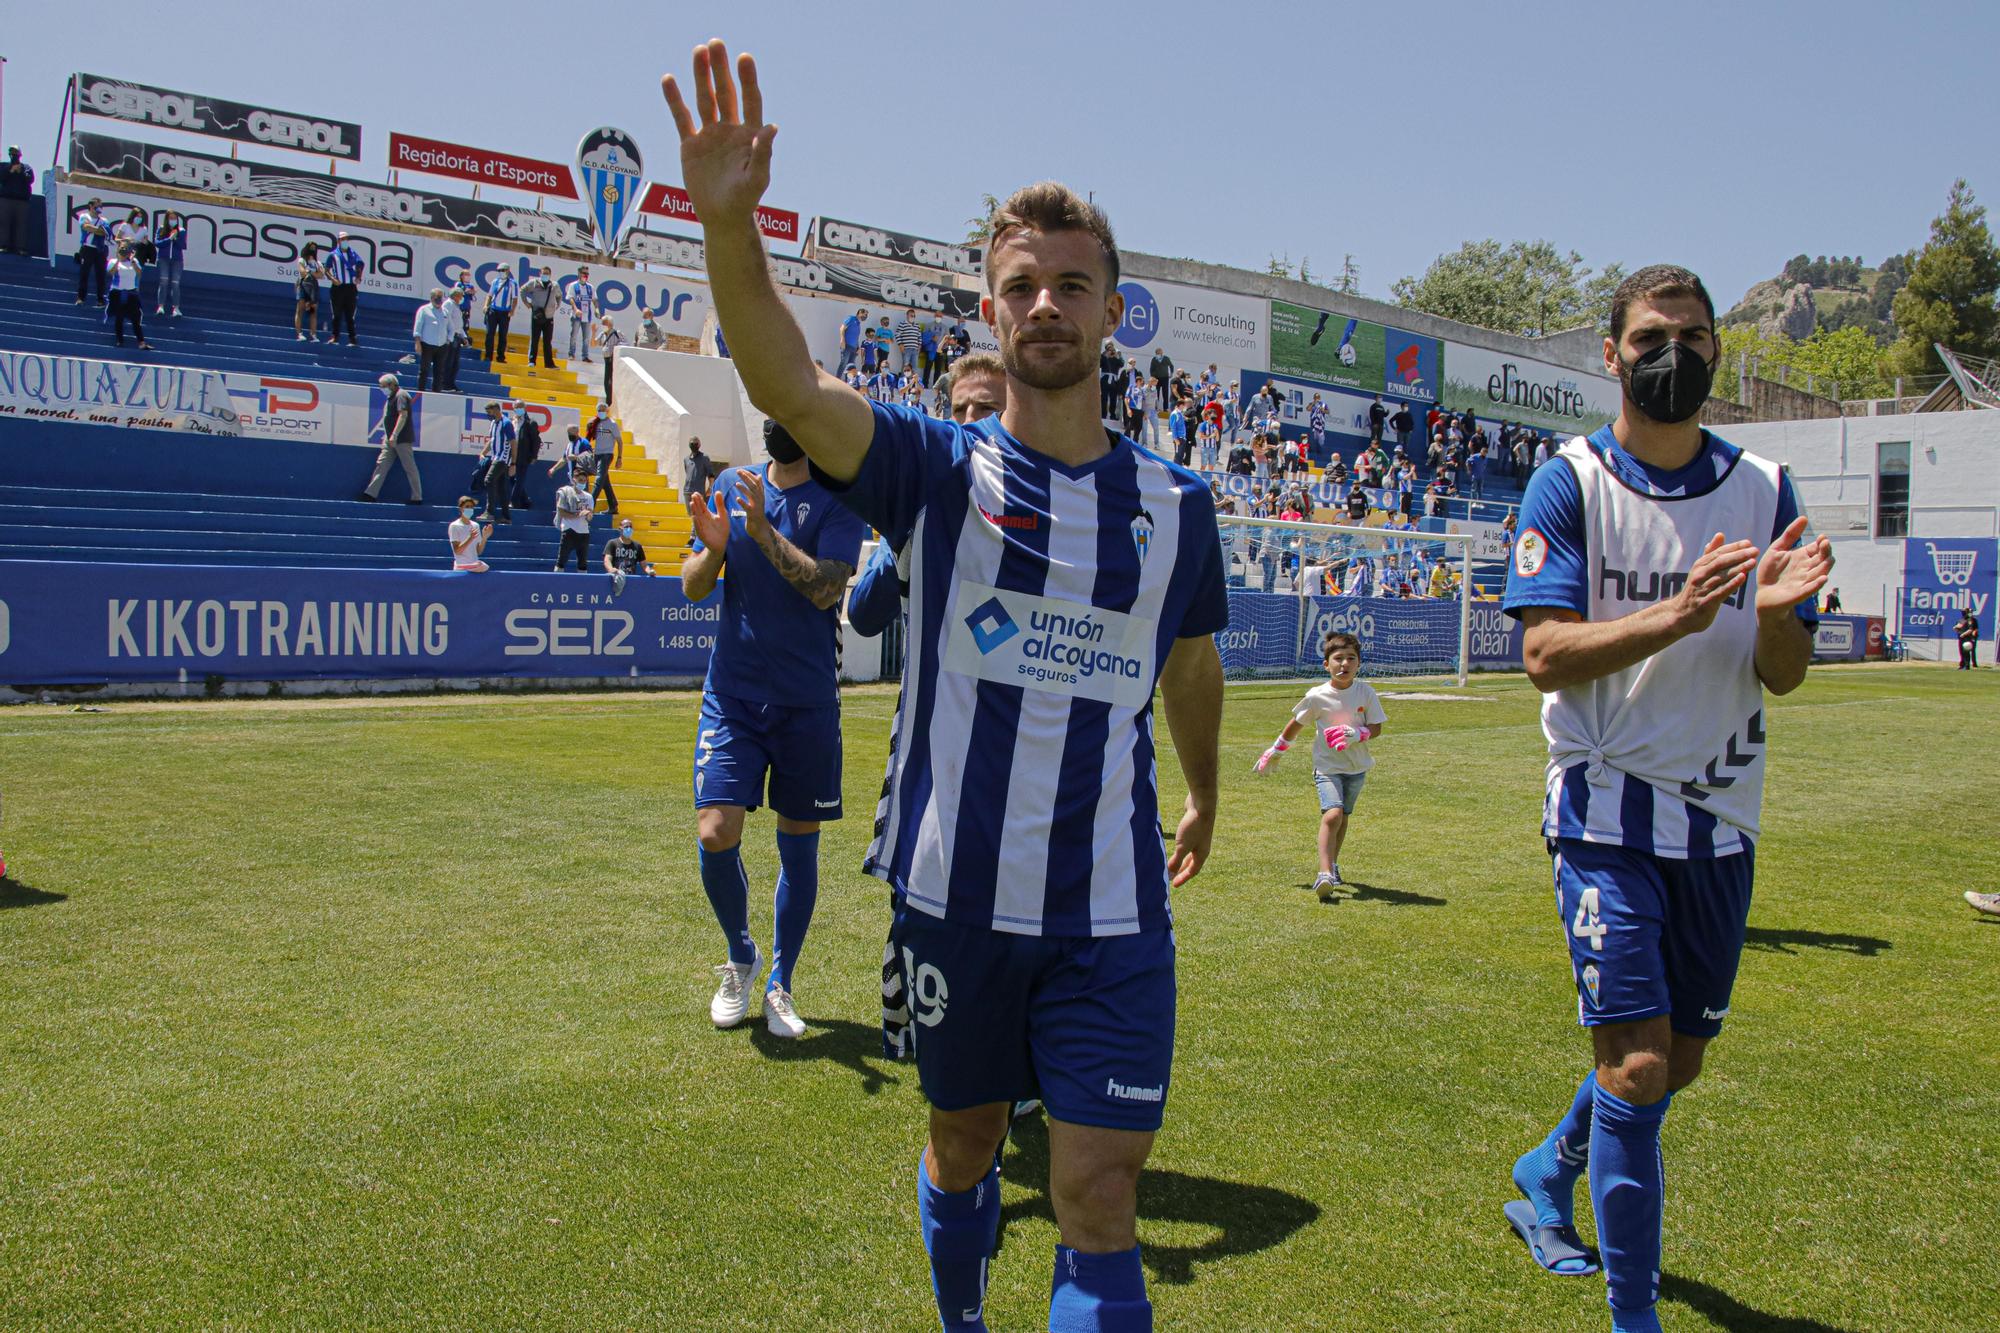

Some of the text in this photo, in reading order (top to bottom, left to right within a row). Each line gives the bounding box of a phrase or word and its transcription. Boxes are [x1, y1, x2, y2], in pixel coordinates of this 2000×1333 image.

[89, 82, 351, 155] CEROL CEROL
[398, 143, 557, 188] Regidoría d'Esports
[600, 164, 639, 176] ALCOYANO
[150, 152, 588, 248] CEROL CEROL CEROL
[824, 222, 981, 276] CEROL CEROL
[386, 281, 413, 292] sana
[880, 279, 945, 312] CEROL
[1174, 306, 1185, 321] IT
[1188, 308, 1256, 335] Consulting
[1173, 328, 1256, 350] www.teknei.com
[89, 413, 118, 424] una
[127, 415, 174, 429] pasión
[270, 419, 322, 431] PORT
[530, 593, 614, 605] CADENA
[1910, 588, 1989, 616] family
[108, 599, 449, 658] KIKOTRAINING
[1030, 610, 1104, 643] unión
[1469, 609, 1502, 633] aqua
[1910, 611, 1945, 626] cash
[504, 608, 636, 656] SER
[658, 635, 694, 649] 1.485
[1220, 625, 1259, 649] cash
[1400, 635, 1429, 646] SEGUROS
[1471, 633, 1510, 656] clean
[1022, 634, 1142, 680] alcoyana
[1018, 664, 1078, 685] seguros
[1572, 887, 1608, 951] 4
[901, 945, 949, 1028] 19
[1106, 1078, 1163, 1102] hummel
